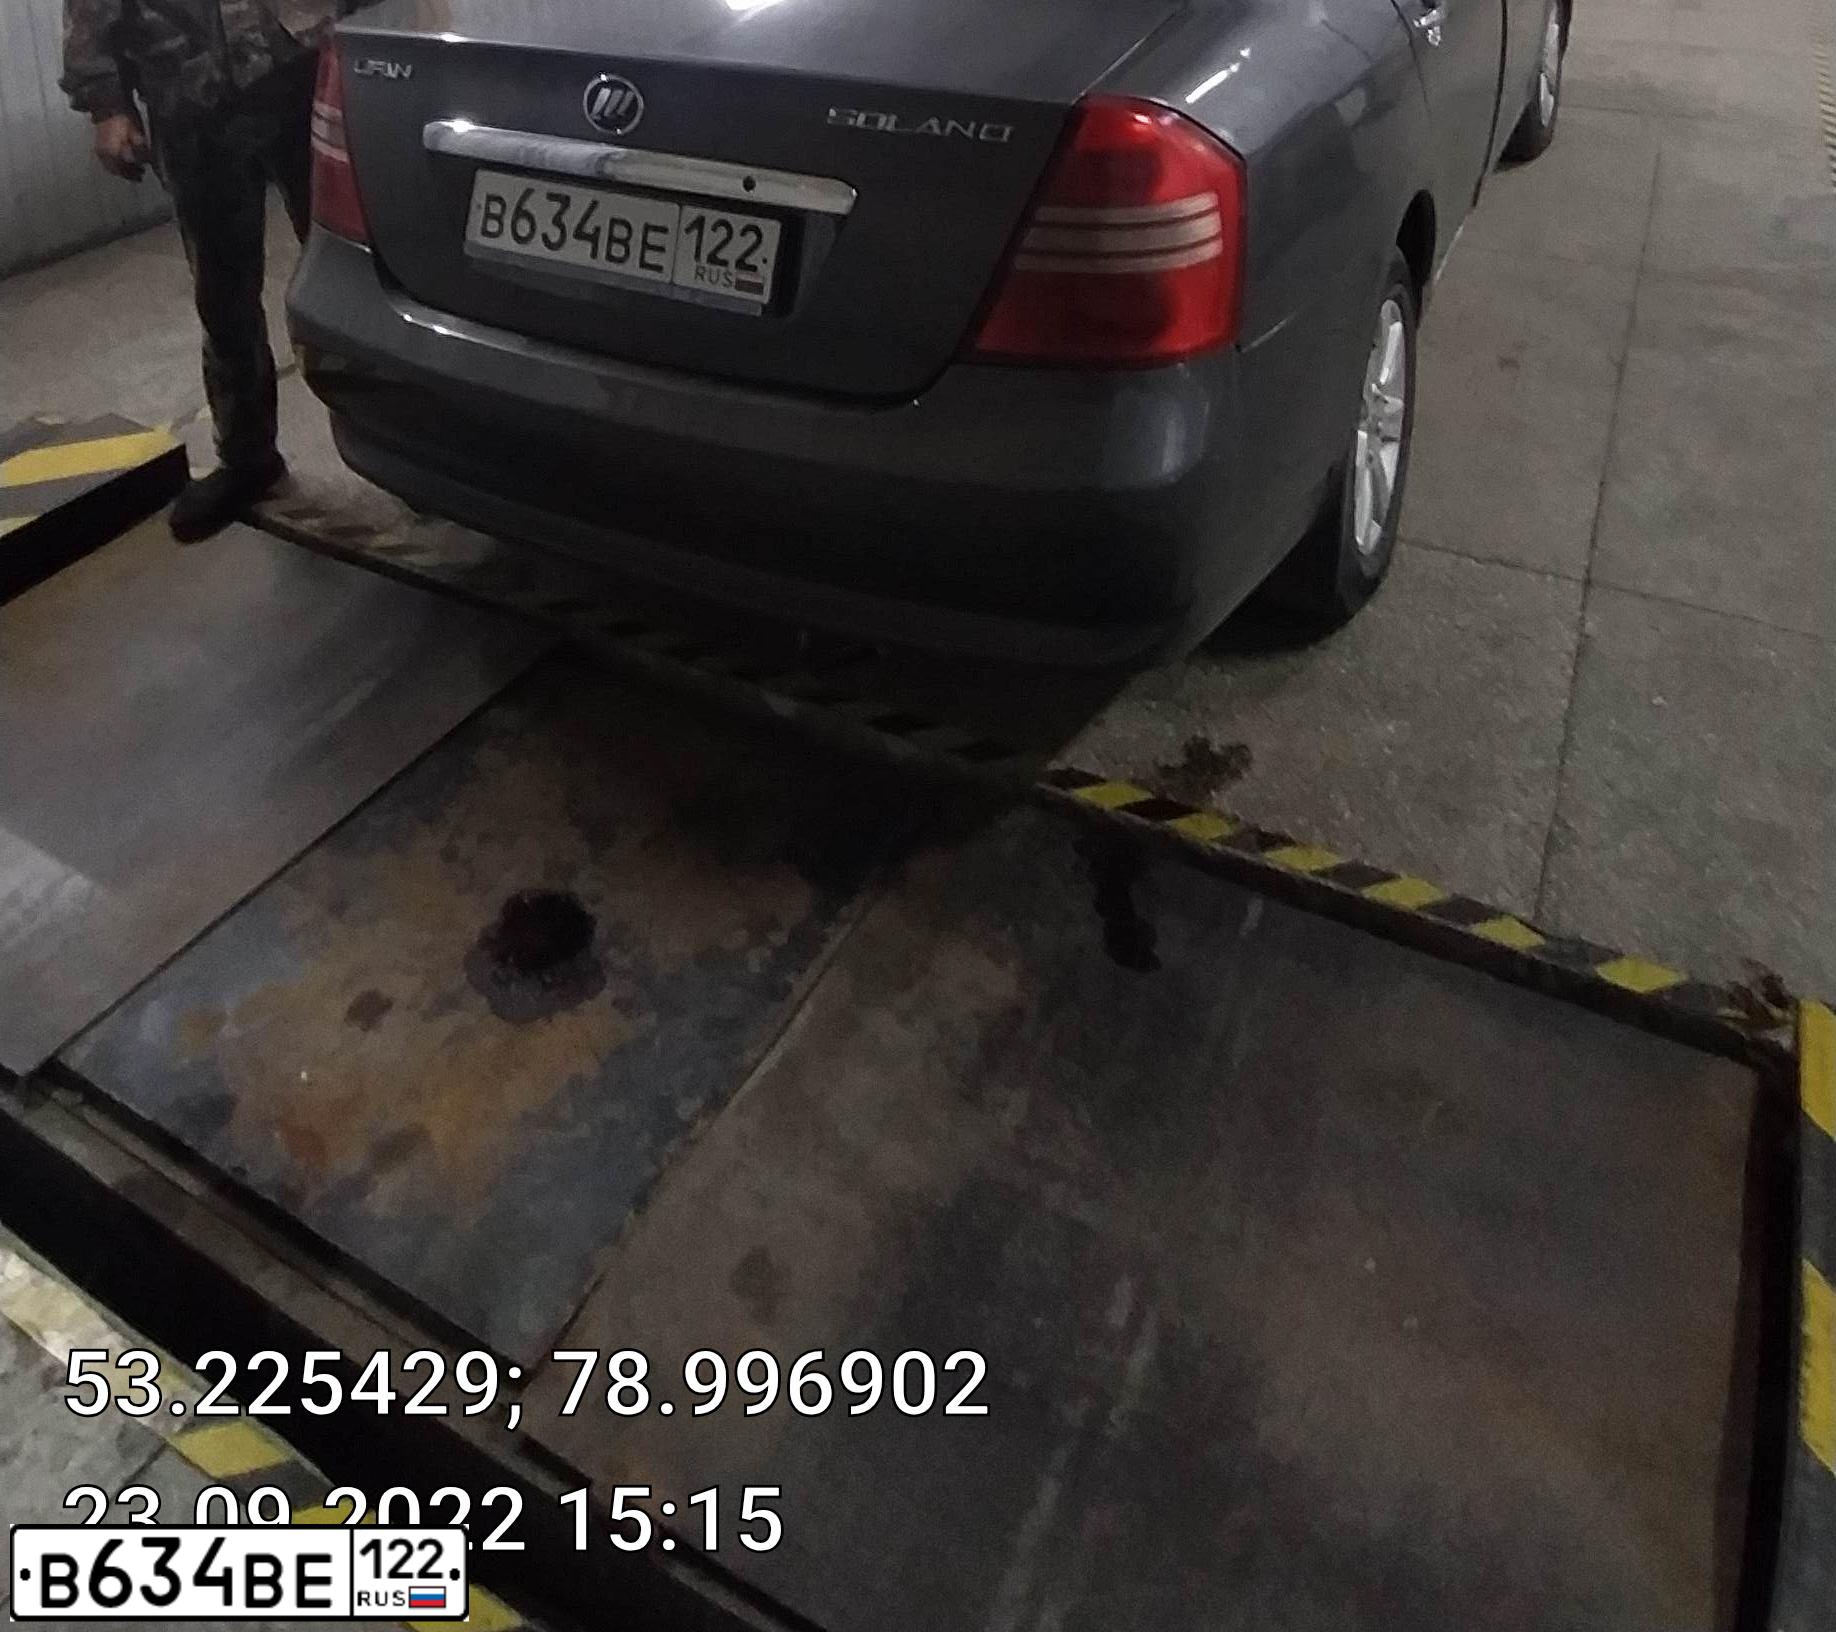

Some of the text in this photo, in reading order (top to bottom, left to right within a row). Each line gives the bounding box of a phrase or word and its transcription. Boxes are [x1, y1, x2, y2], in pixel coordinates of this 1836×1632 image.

[827, 108, 1014, 143] SOLANO
[480, 187, 763, 273] B634BE 122
[694, 264, 734, 289] RUS
